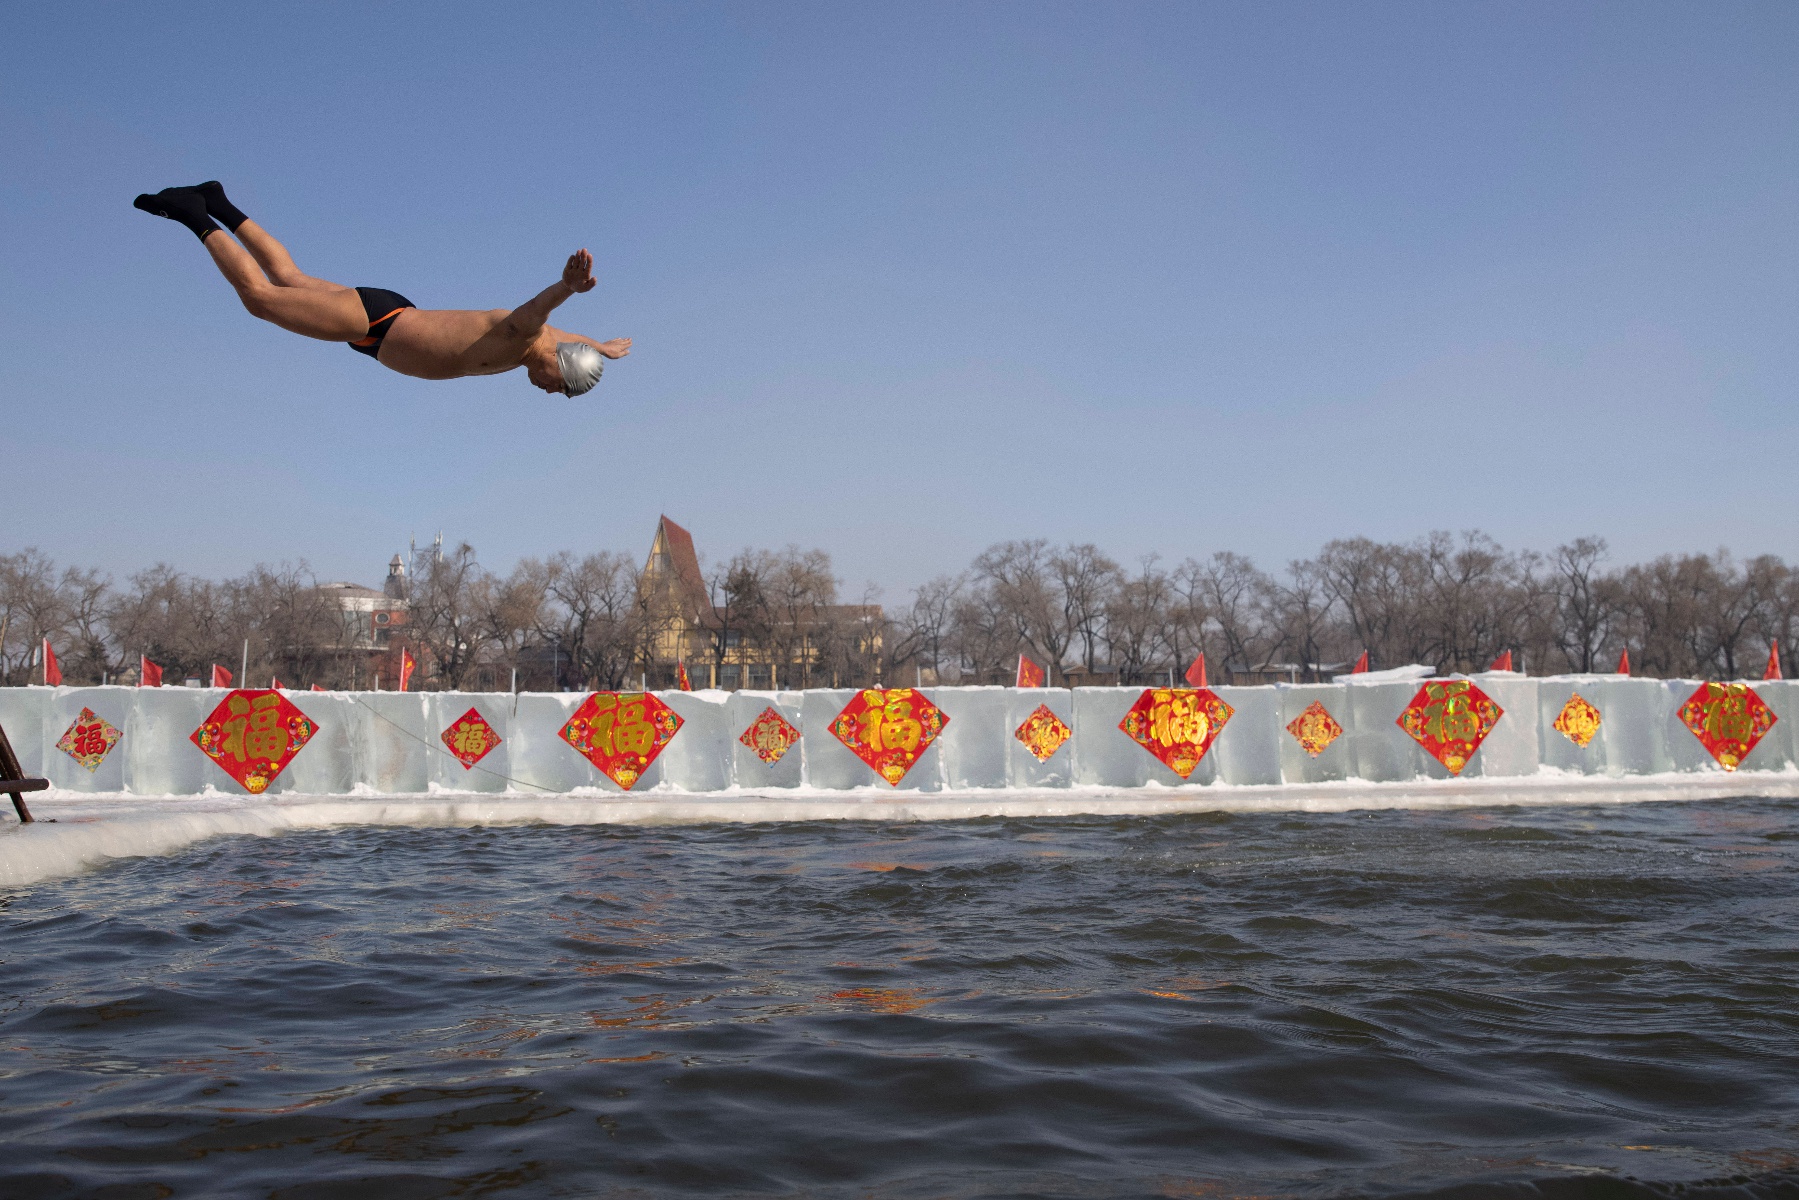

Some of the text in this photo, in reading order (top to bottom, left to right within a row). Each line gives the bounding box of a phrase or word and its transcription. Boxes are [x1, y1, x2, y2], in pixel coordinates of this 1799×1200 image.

[74, 724, 107, 757] 福
[222, 693, 288, 762] 福
[454, 722, 486, 756] 福
[590, 693, 655, 757] 福
[859, 689, 922, 752] 福
[1151, 689, 1208, 747] 福
[1425, 681, 1478, 743] 福
[1703, 682, 1754, 742] 福
